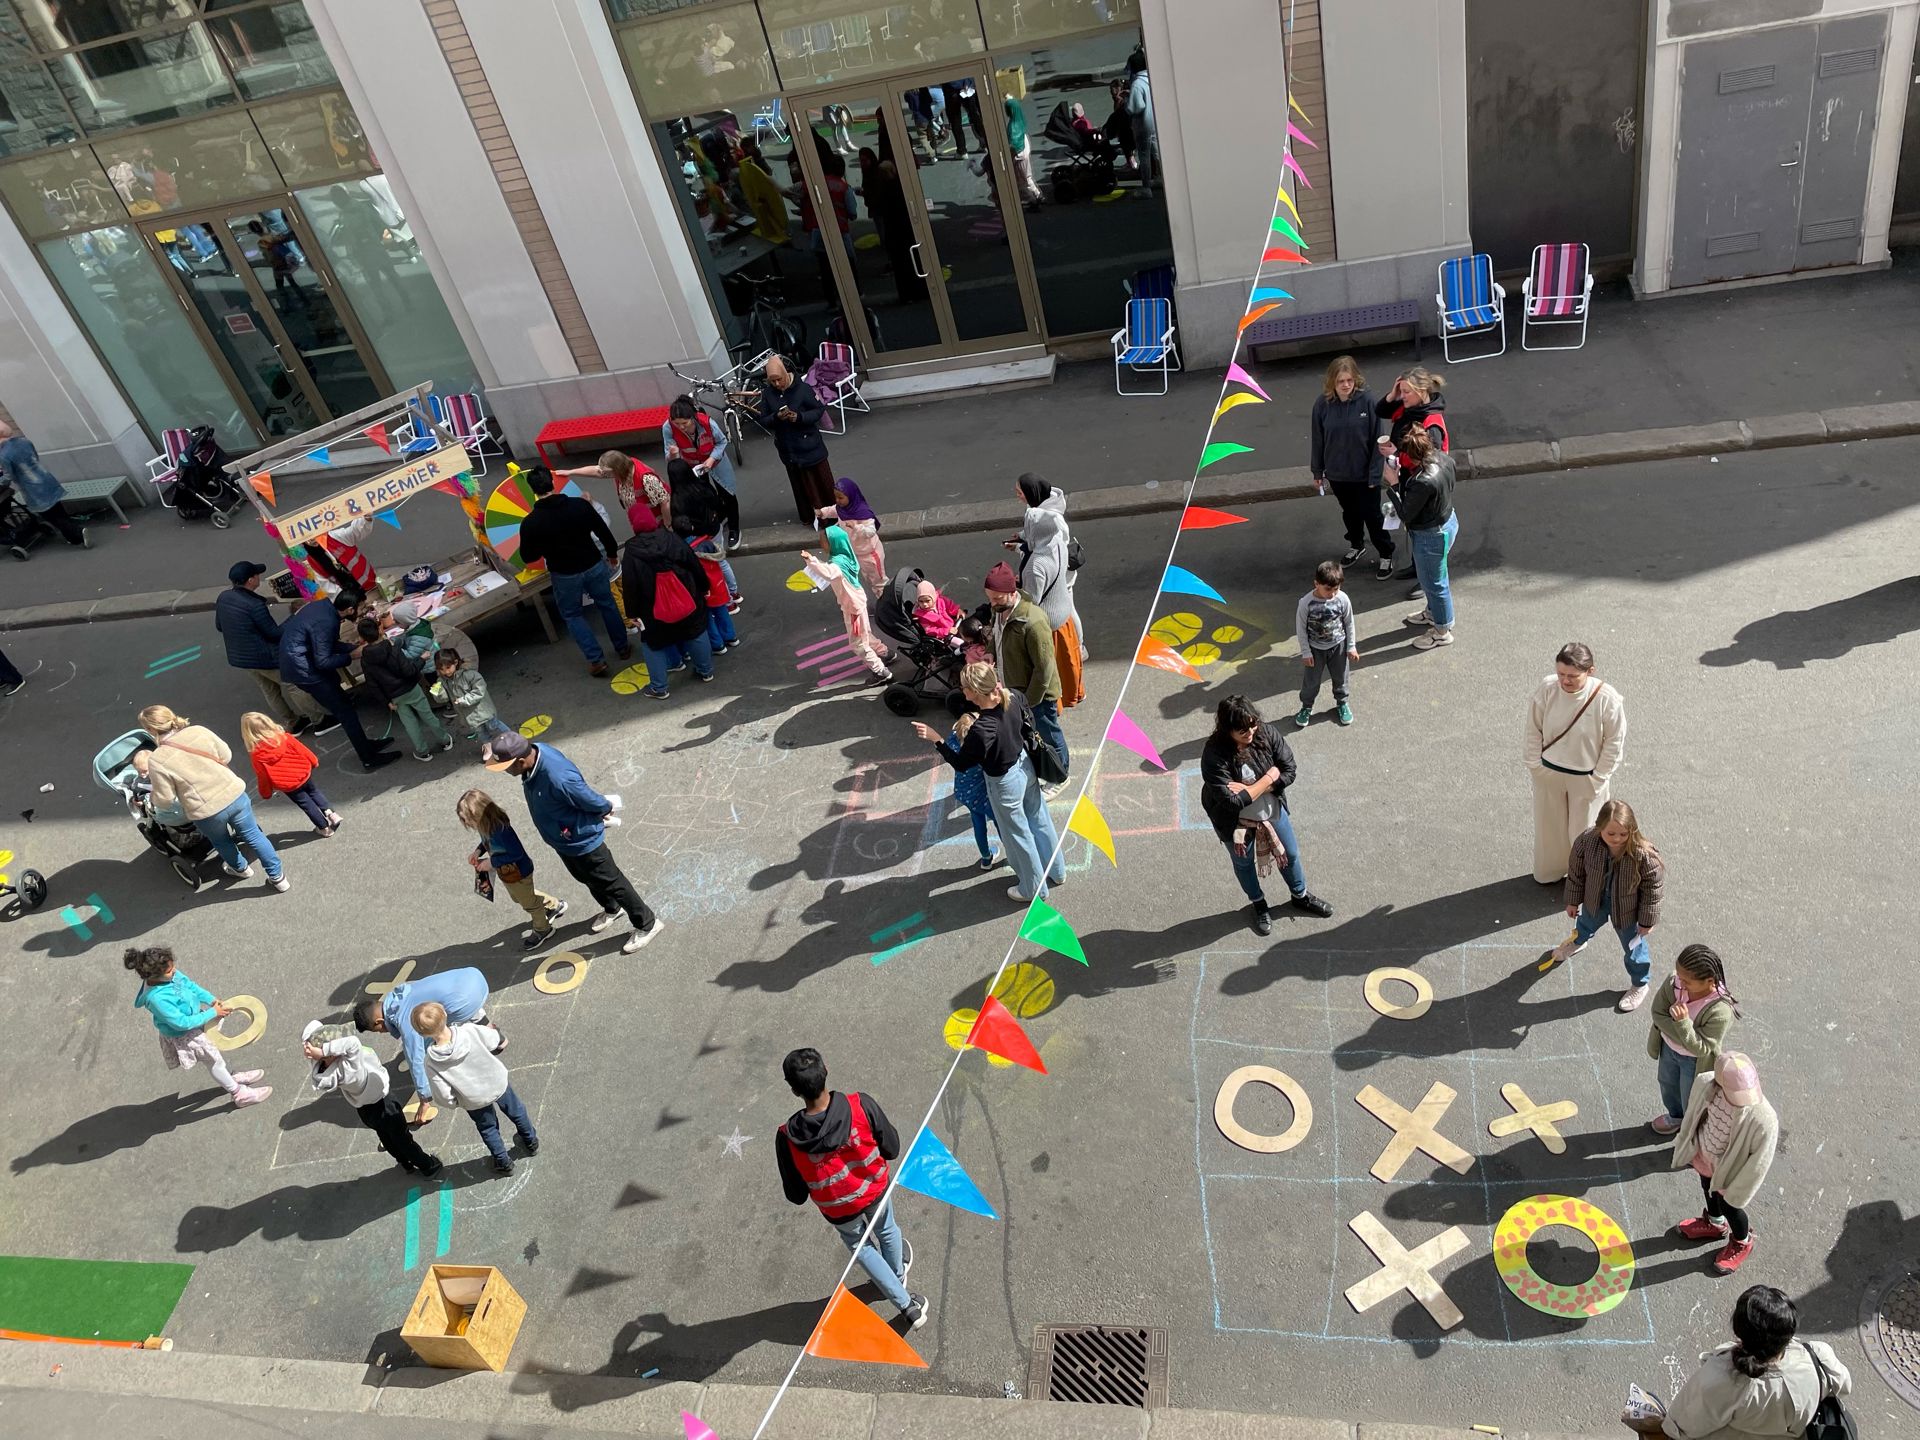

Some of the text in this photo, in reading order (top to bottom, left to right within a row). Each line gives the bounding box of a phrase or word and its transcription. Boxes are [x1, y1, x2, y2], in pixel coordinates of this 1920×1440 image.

[288, 461, 441, 540] INFO & PREMIER
